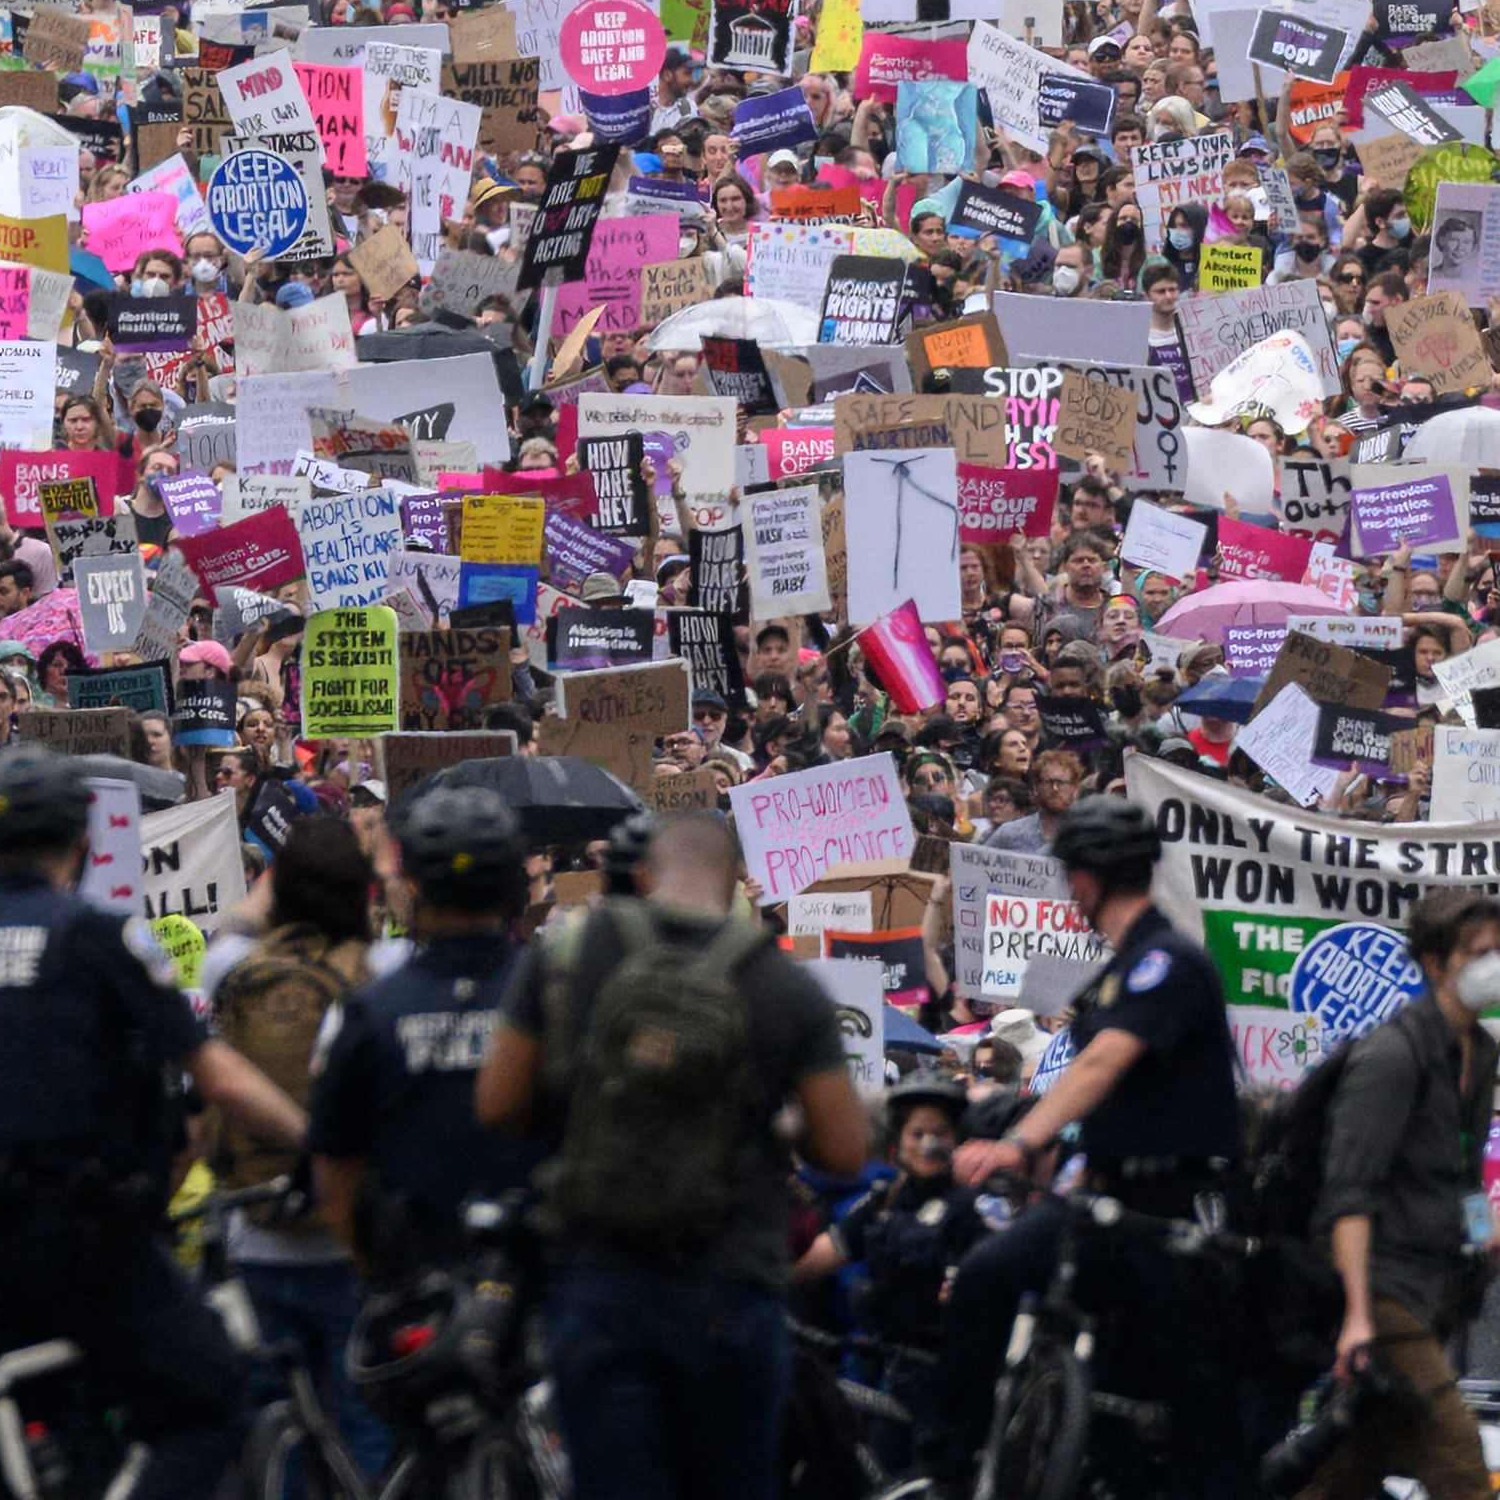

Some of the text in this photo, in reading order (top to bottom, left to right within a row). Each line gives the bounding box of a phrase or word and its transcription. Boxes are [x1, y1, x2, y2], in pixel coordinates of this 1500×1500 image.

[593, 10, 629, 29] KEEP
[579, 28, 645, 47] ABORTION
[580, 45, 645, 66] SAFE AND
[1271, 41, 1323, 66] BODY
[236, 66, 284, 101] MIND
[593, 63, 635, 81] LEGAL
[258, 130, 318, 153] STARTS
[1137, 134, 1232, 161] KEEP YOUR
[224, 154, 284, 184] KEEP
[1145, 156, 1229, 181] LAWS OFF
[1157, 175, 1186, 197] MY
[212, 183, 304, 216] ABORTION
[222, 211, 297, 241] LEGAL
[1210, 247, 1252, 263] Protect
[1203, 261, 1257, 276] Abortion
[1212, 275, 1250, 289] Rights
[825, 295, 896, 318] RIGHTS
[835, 318, 893, 340] HUMAN
[983, 366, 1064, 397] STOP
[853, 425, 948, 450] ABORTION
[587, 441, 629, 467] HOW
[303, 496, 397, 532] ABORTION
[341, 522, 362, 534] IS
[304, 528, 402, 568] HEALTHCARE
[88, 571, 134, 604] EXPECT
[311, 563, 359, 593] BANS
[106, 603, 127, 635] US
[334, 611, 368, 628] THE
[316, 629, 384, 647] SYSTEM
[401, 630, 500, 657] HANDS
[309, 647, 392, 667] IS SEXIST!
[425, 657, 478, 678] OFF
[312, 676, 388, 696] FIGHT FOR
[308, 694, 394, 716] SOCIALISM!
[752, 774, 890, 829] PRO-WOMEN
[1157, 797, 1276, 853] ONLY
[1296, 827, 1381, 870] THE
[1191, 856, 1298, 903] WON
[988, 899, 1028, 928] NO
[1233, 923, 1304, 952] THE
[1342, 927, 1423, 988] KEEP
